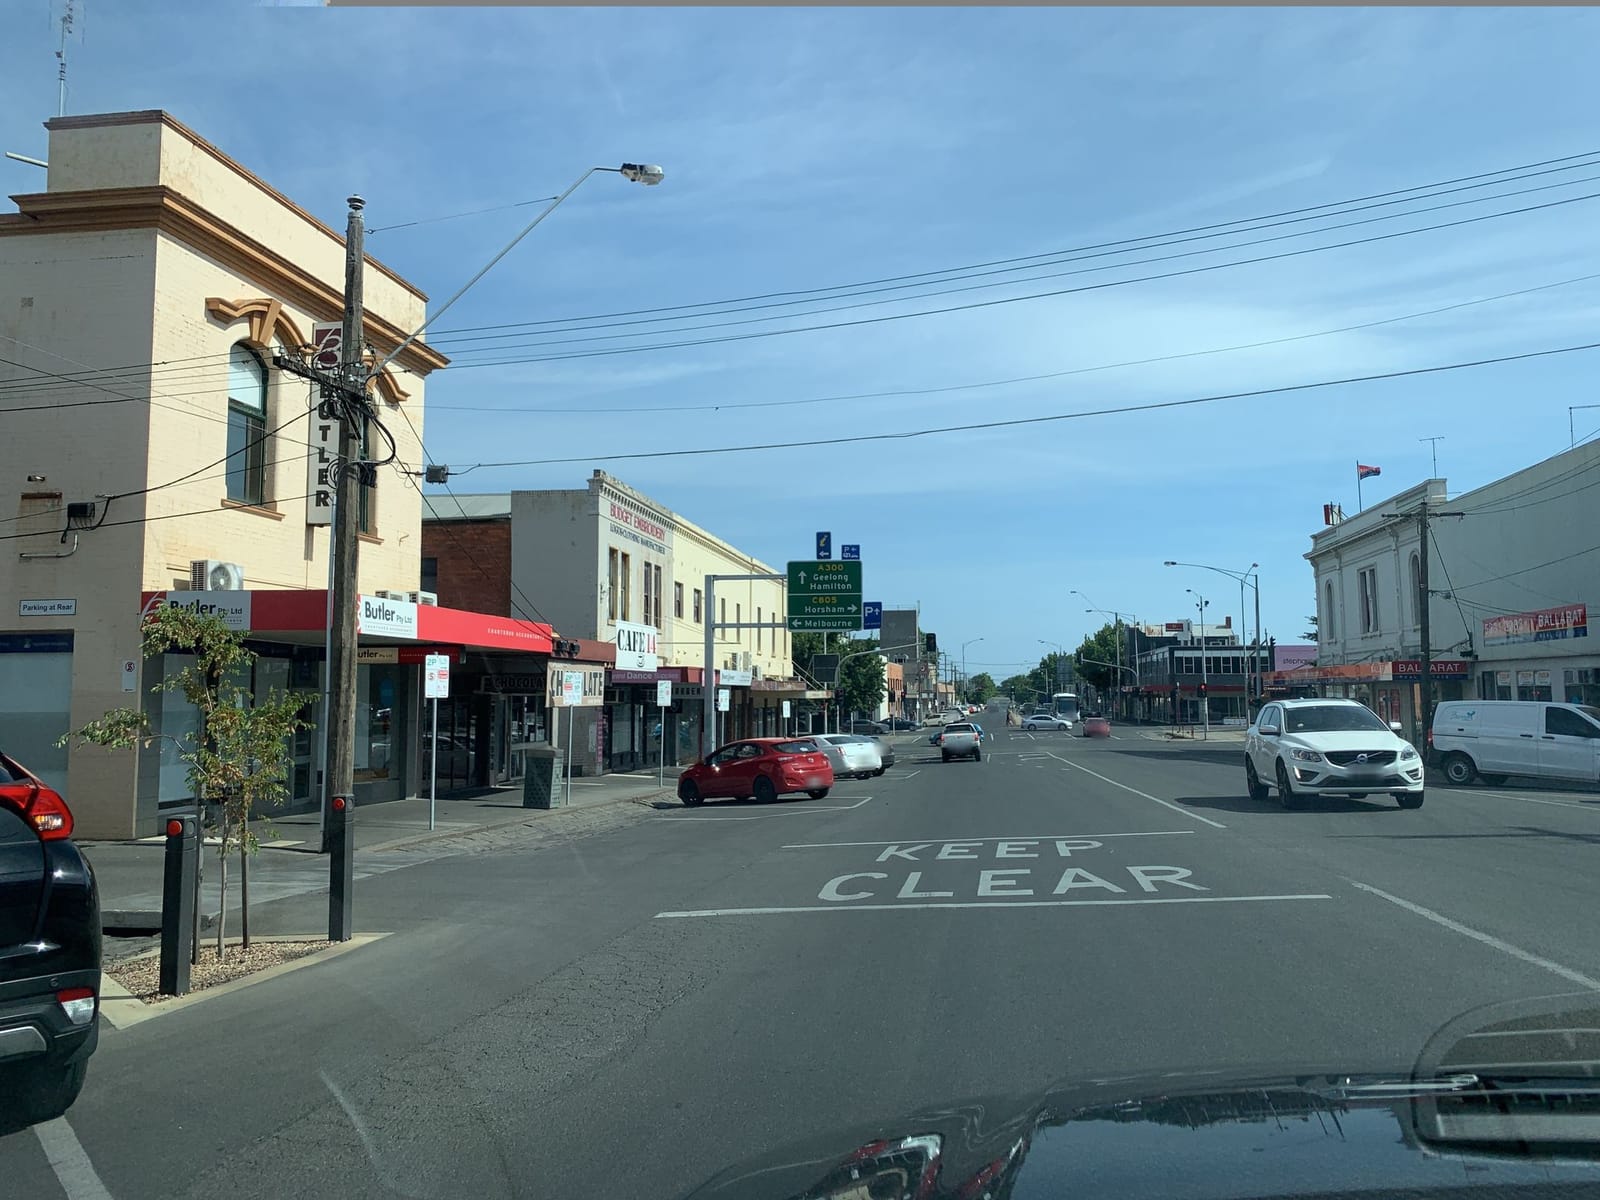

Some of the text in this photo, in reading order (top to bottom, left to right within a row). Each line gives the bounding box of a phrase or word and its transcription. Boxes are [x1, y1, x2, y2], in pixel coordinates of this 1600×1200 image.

[610, 503, 633, 526] BUDGET
[817, 563, 844, 571] A300
[813, 573, 849, 582] Geelong
[22, 604, 48, 612] Parking
[230, 607, 243, 615] Ltd
[364, 600, 413, 625] Butler Pty Ltd
[804, 606, 845, 614] Horsham
[864, 606, 874, 617] P
[1537, 609, 1583, 628] BALLARAT
[804, 620, 853, 628] Melbourne
[617, 628, 656, 654] CAFE 14
[357, 649, 379, 659] utler
[1398, 663, 1460, 672] BALARAT
[626, 672, 653, 680] Dance
[550, 670, 603, 697] CHLATE
[876, 839, 1103, 862] KEEP
[816, 865, 1210, 902] CLEAR
